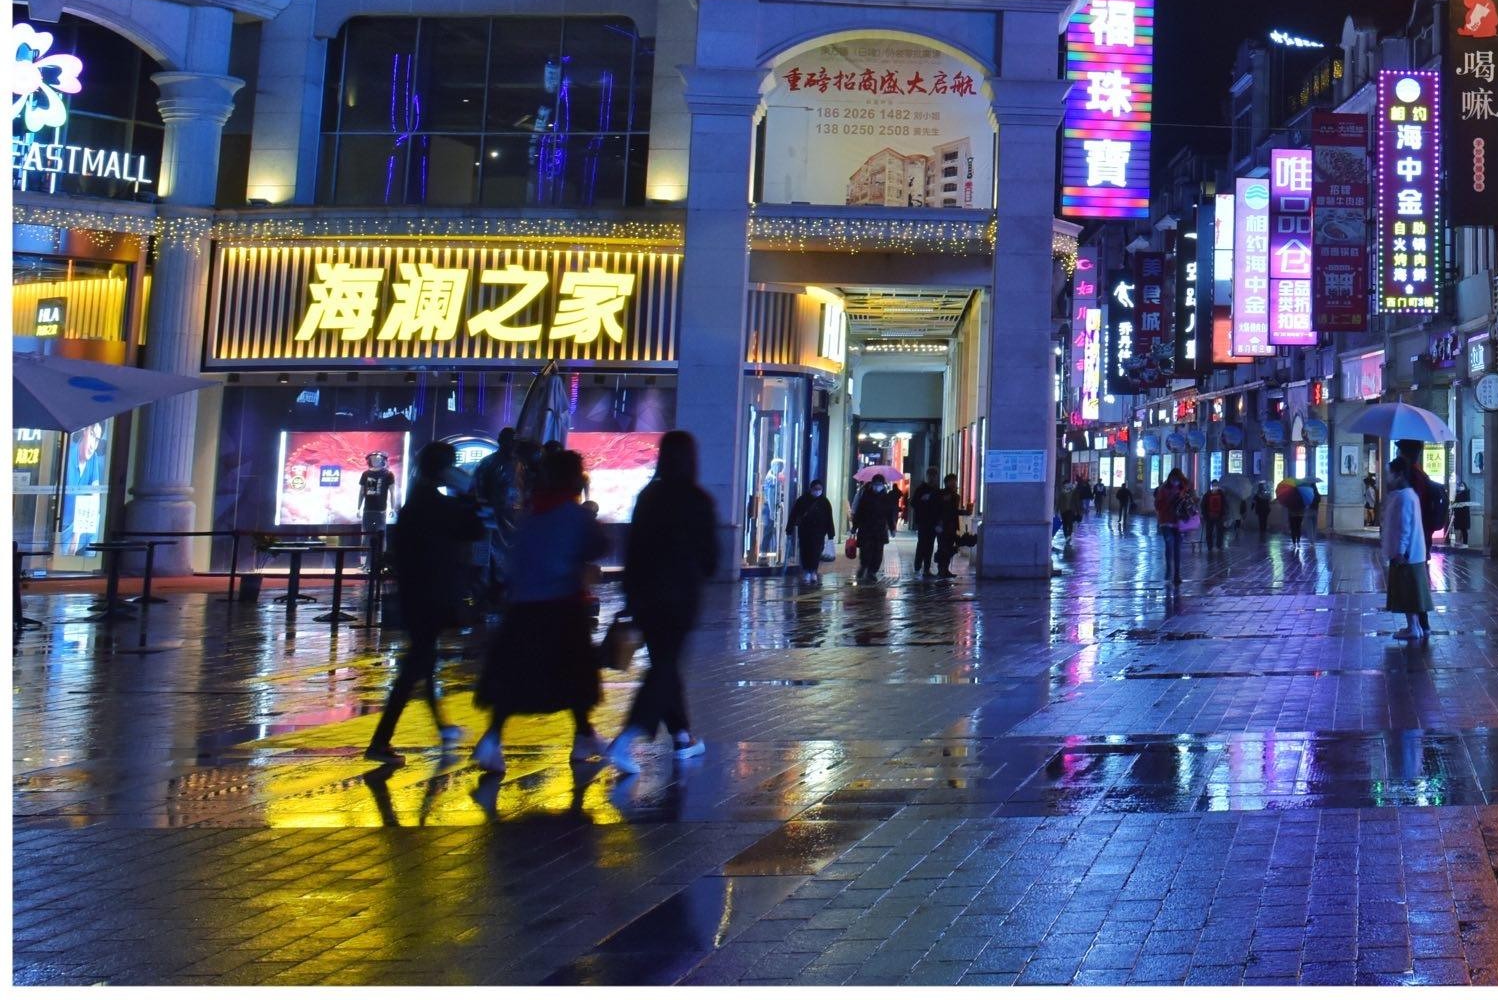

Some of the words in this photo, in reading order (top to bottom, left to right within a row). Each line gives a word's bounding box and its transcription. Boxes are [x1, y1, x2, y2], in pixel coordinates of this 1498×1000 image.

[783, 67, 977, 97] 重磅招商盛大启航
[817, 107, 840, 119] 186
[843, 107, 875, 120] 2026
[880, 108, 911, 120] 1482
[816, 123, 839, 134] 138
[843, 124, 874, 136] 0250
[879, 124, 910, 136] 2508
[1397, 126, 1423, 215] 海中金
[295, 261, 636, 345] 海澜之家
[38, 308, 60, 323] HLA
